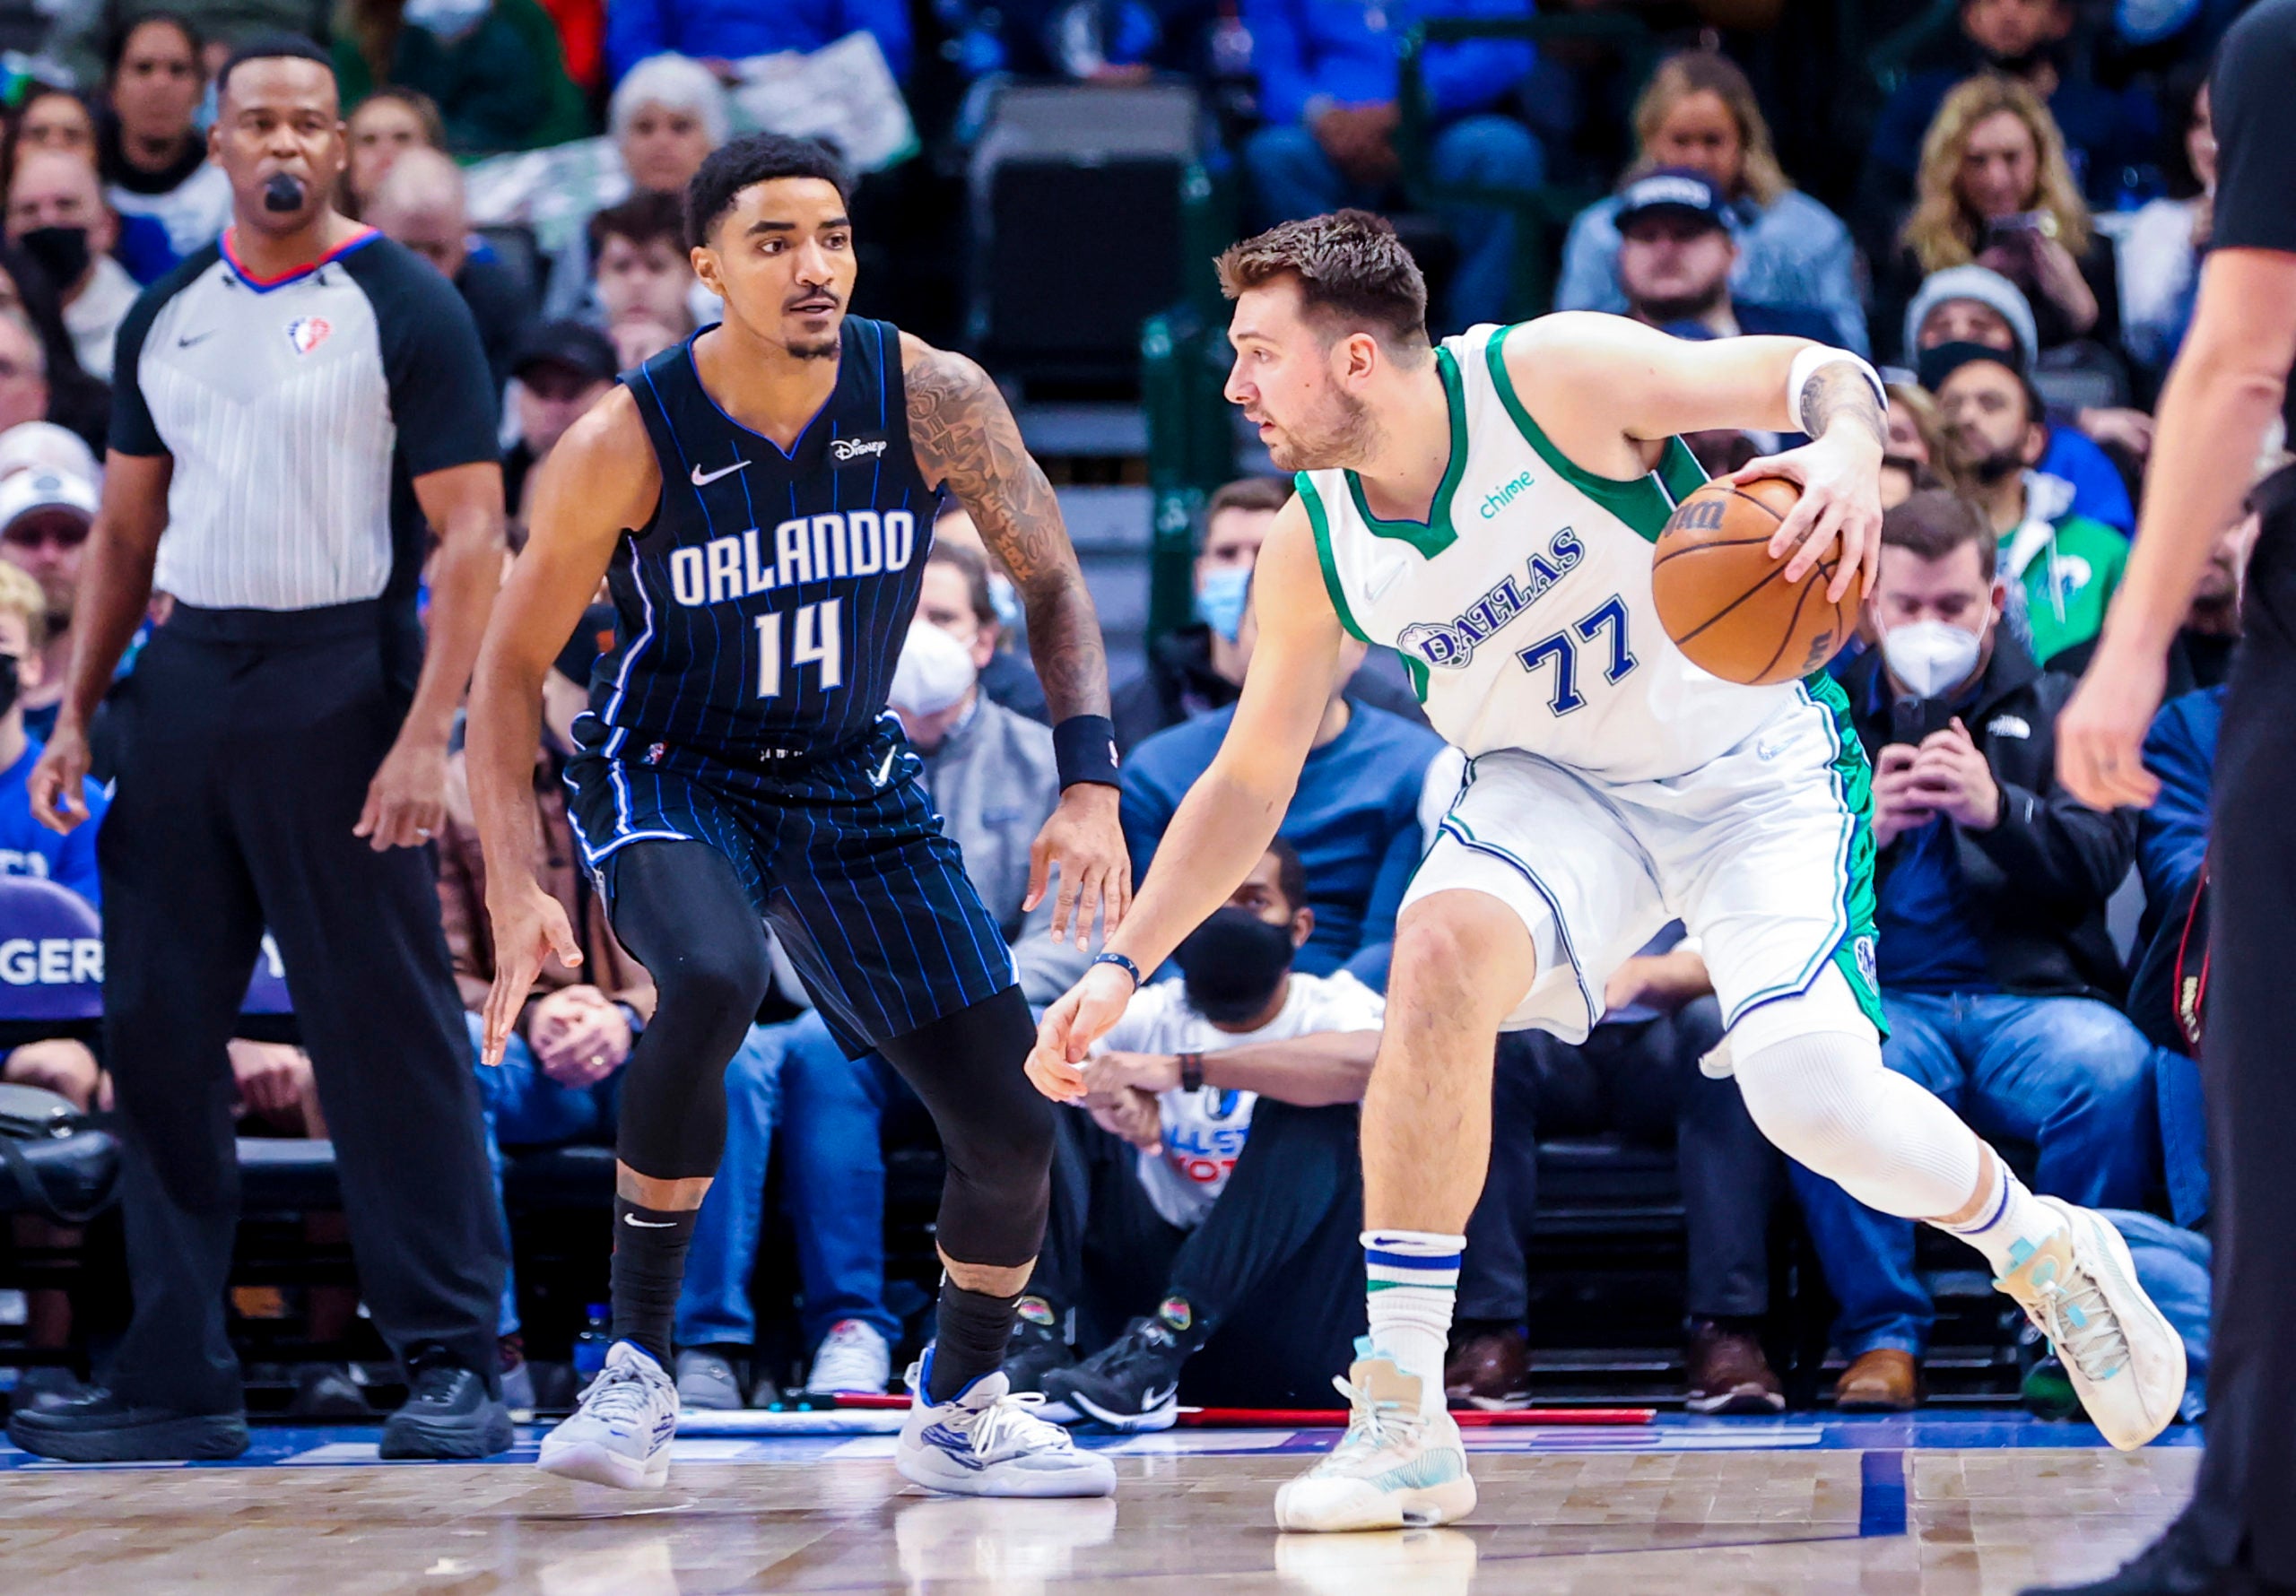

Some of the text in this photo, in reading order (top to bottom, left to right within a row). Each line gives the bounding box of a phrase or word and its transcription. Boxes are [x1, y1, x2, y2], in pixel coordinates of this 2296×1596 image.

[831, 438, 887, 461] Disney
[1480, 470, 1535, 520] chime
[669, 508, 915, 608] ORLANDO
[1418, 525, 1586, 664] DALLAS
[753, 595, 844, 701] 14
[1515, 592, 1640, 718] 77
